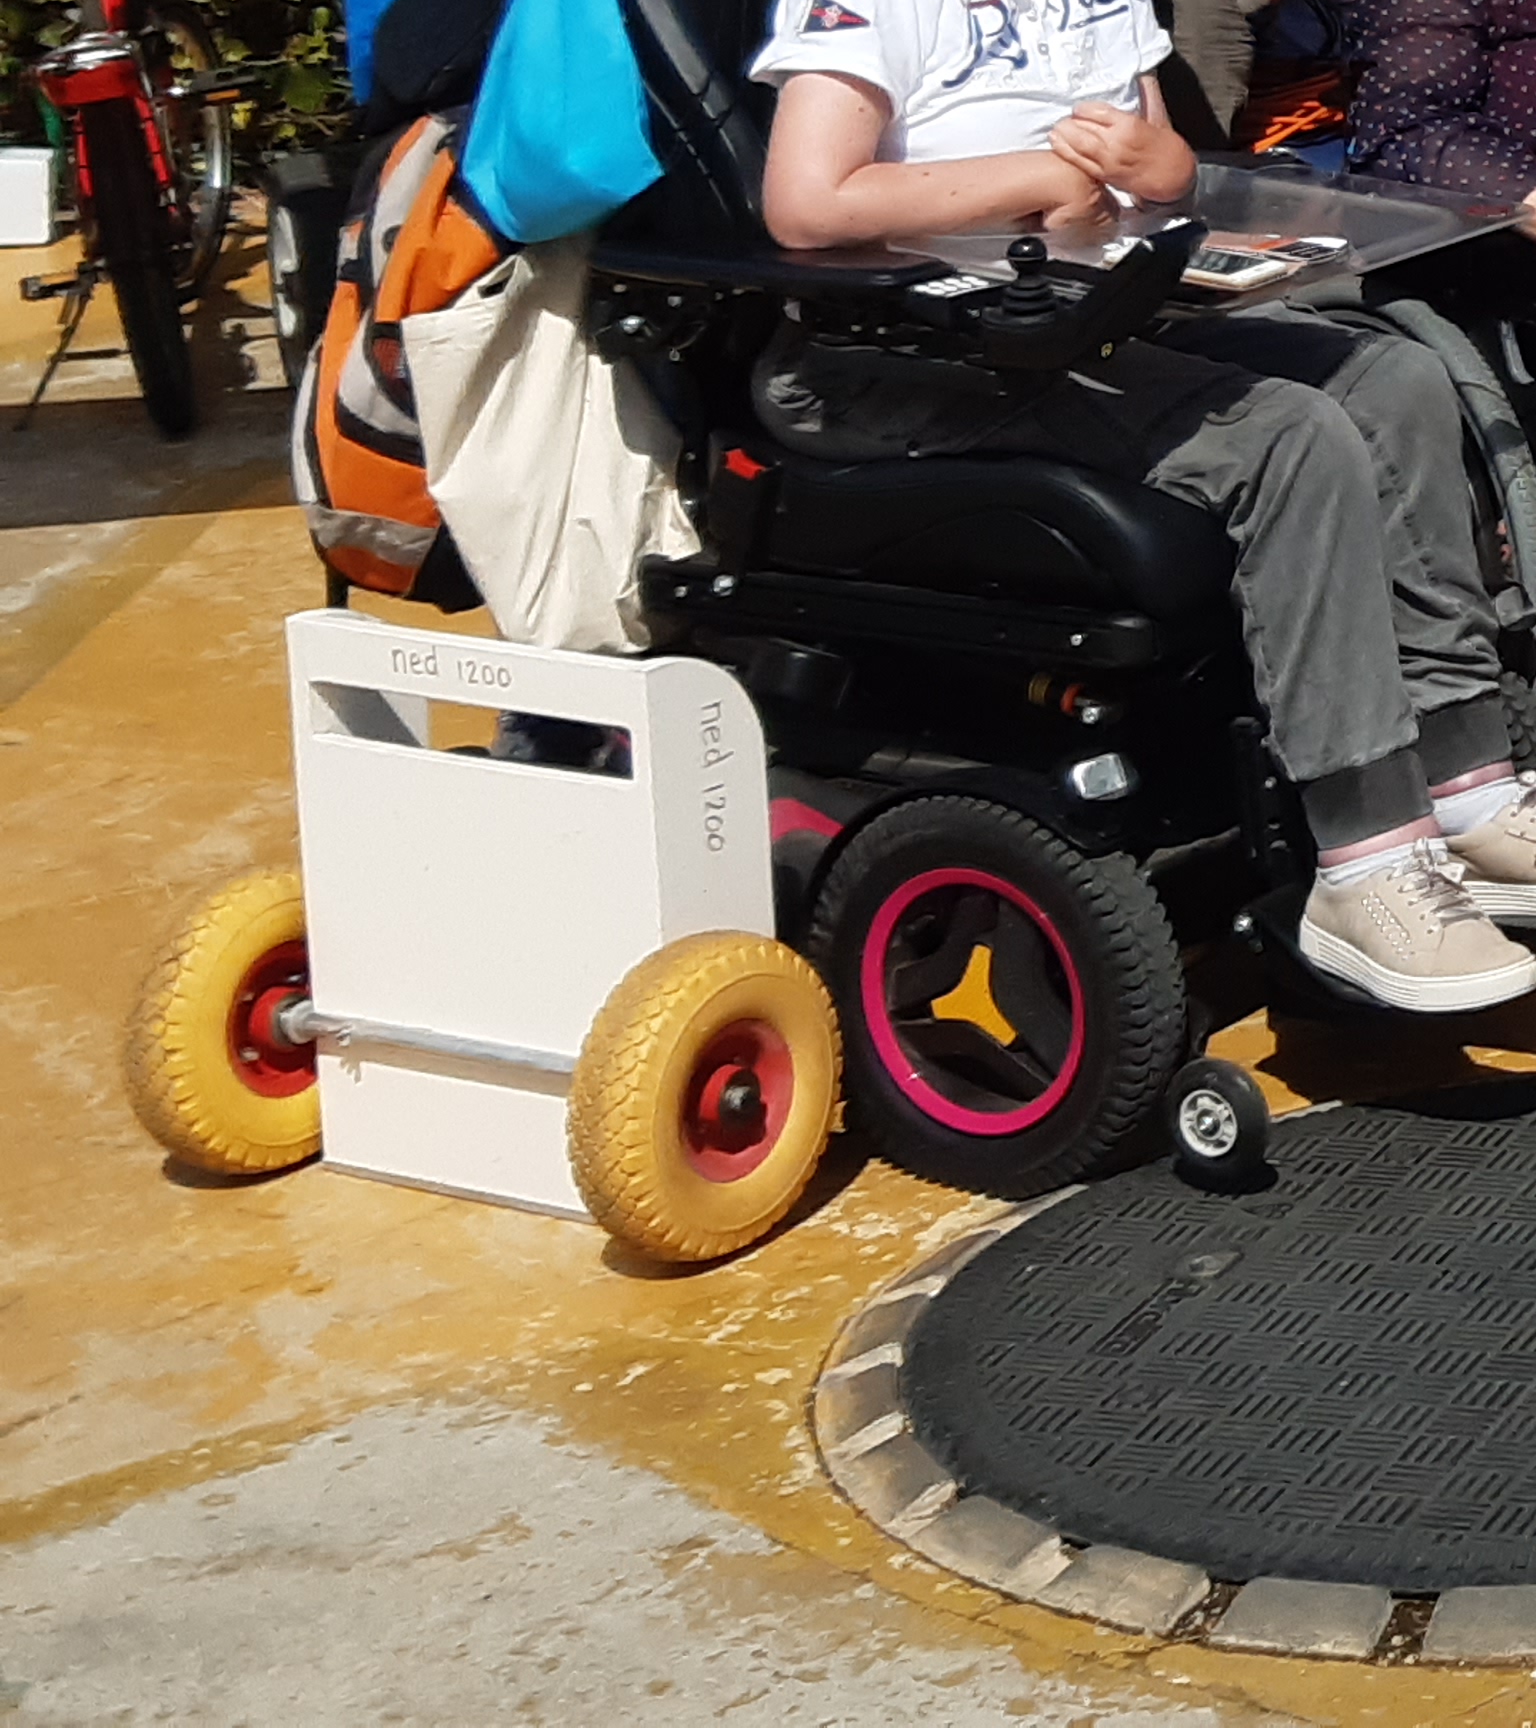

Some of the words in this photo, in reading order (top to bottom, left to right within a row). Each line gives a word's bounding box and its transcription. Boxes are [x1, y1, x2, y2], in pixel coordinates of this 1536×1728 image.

[391, 645, 439, 676] ned
[456, 659, 513, 688] 1200
[699, 699, 735, 770] ned
[702, 782, 726, 853] 1200
